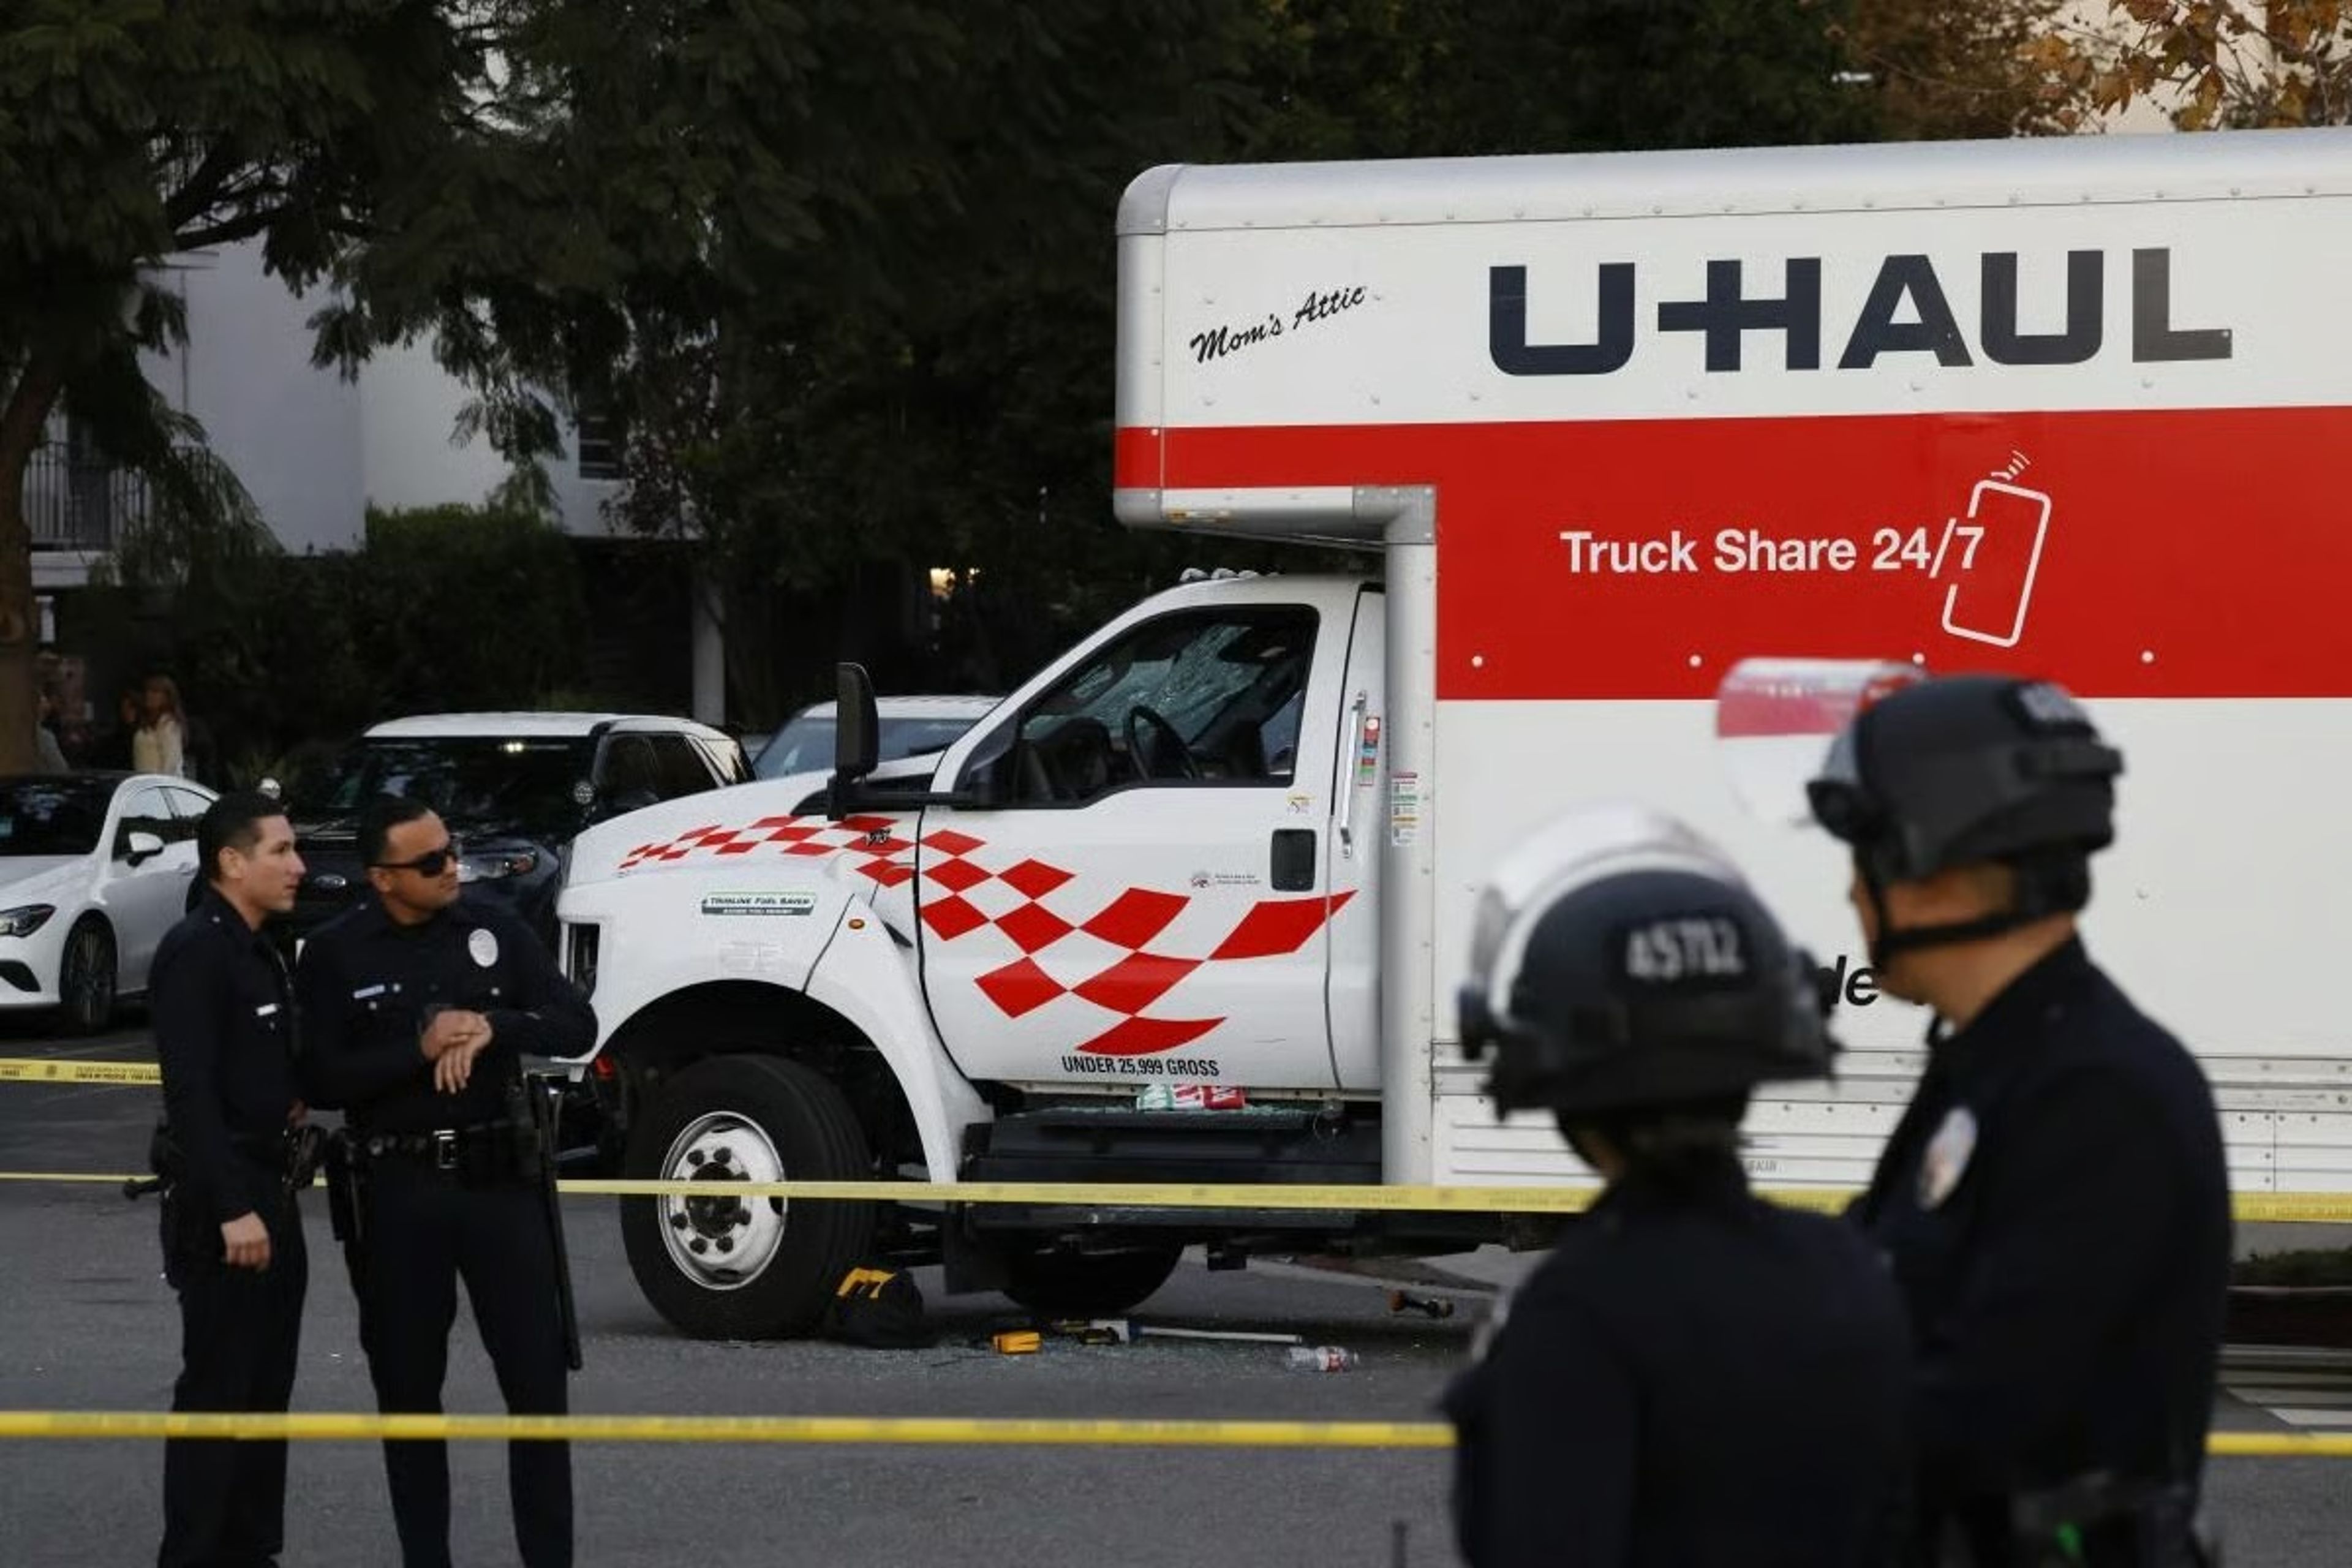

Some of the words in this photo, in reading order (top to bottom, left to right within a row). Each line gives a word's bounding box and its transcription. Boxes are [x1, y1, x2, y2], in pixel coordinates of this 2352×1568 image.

[1189, 314, 1283, 364] Mom's
[1293, 286, 1366, 330] Attic
[1560, 530, 1698, 573] Truck
[1714, 529, 1856, 571] Share
[1872, 518, 1985, 578] 24/7
[1061, 1055, 1115, 1072] UNDER
[1118, 1058, 1163, 1076] 25,999
[1166, 1058, 1220, 1076] GROSS
